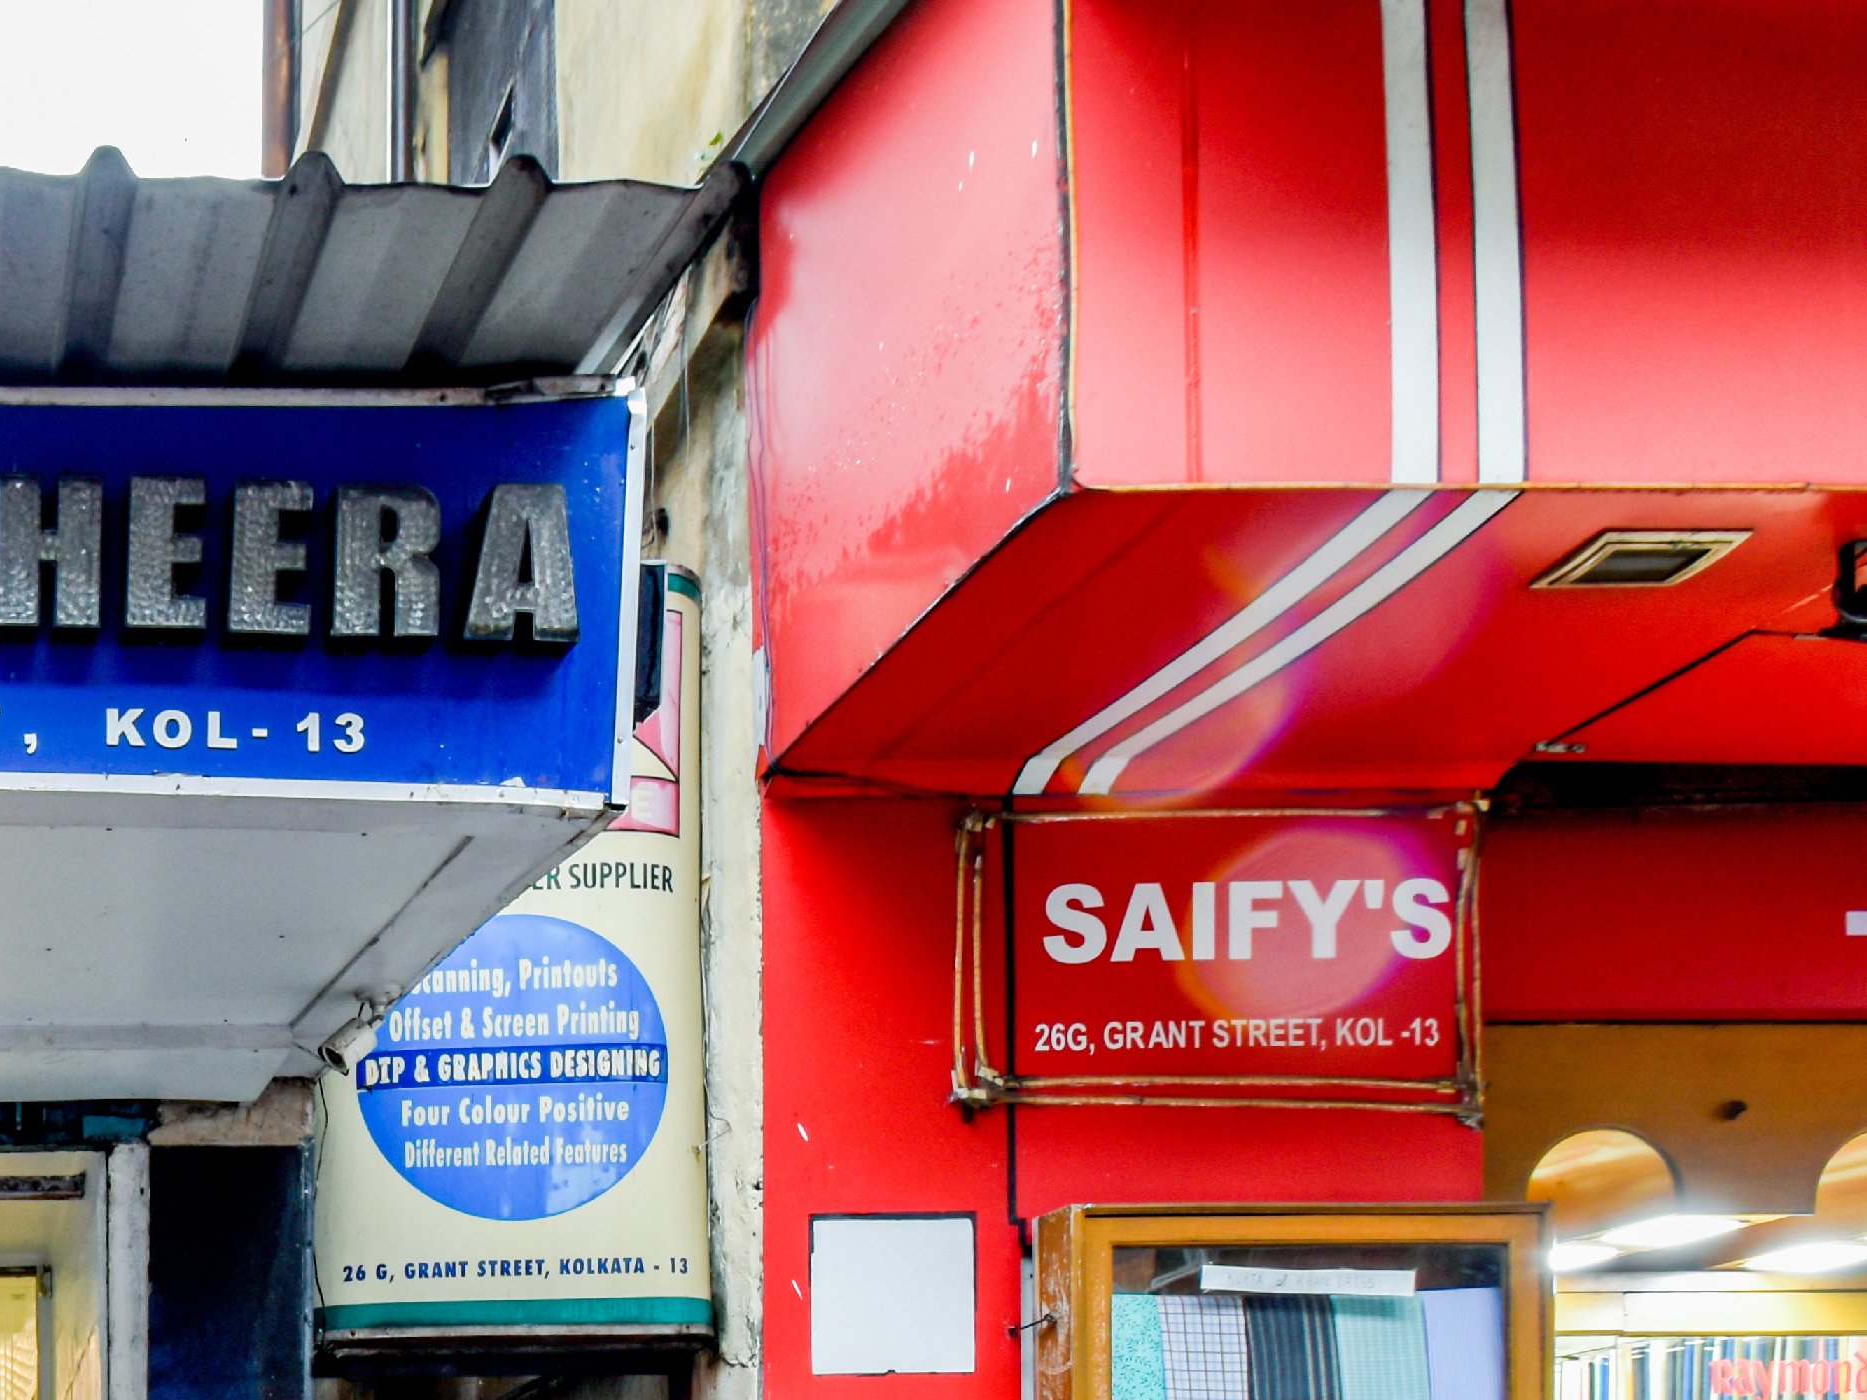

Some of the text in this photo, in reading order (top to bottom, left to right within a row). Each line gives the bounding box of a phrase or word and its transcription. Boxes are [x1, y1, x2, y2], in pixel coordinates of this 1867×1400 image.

[296, 711, 366, 754] 13
[568, 862, 674, 893] SUPPLIER
[1042, 879, 1453, 964] SAIFY'S
[518, 956, 618, 991] Printouts
[388, 1000, 640, 1043] Offset & Screen Printing
[1034, 1022, 1095, 1056] 26G,
[1103, 1021, 1205, 1050] GRANT
[1212, 1020, 1328, 1051] STREET,
[1336, 1019, 1394, 1047] KOL
[365, 1048, 661, 1086] DTP & GRAPHICS DESIGNING
[401, 1092, 631, 1127] Four Colour Positive
[404, 1136, 628, 1169] Different Related Features
[342, 1264, 367, 1283] 26
[404, 1260, 469, 1281] GRANT
[476, 1258, 551, 1280] STREET,
[559, 1256, 645, 1276] KOLKATA
[670, 1257, 689, 1275] 13
